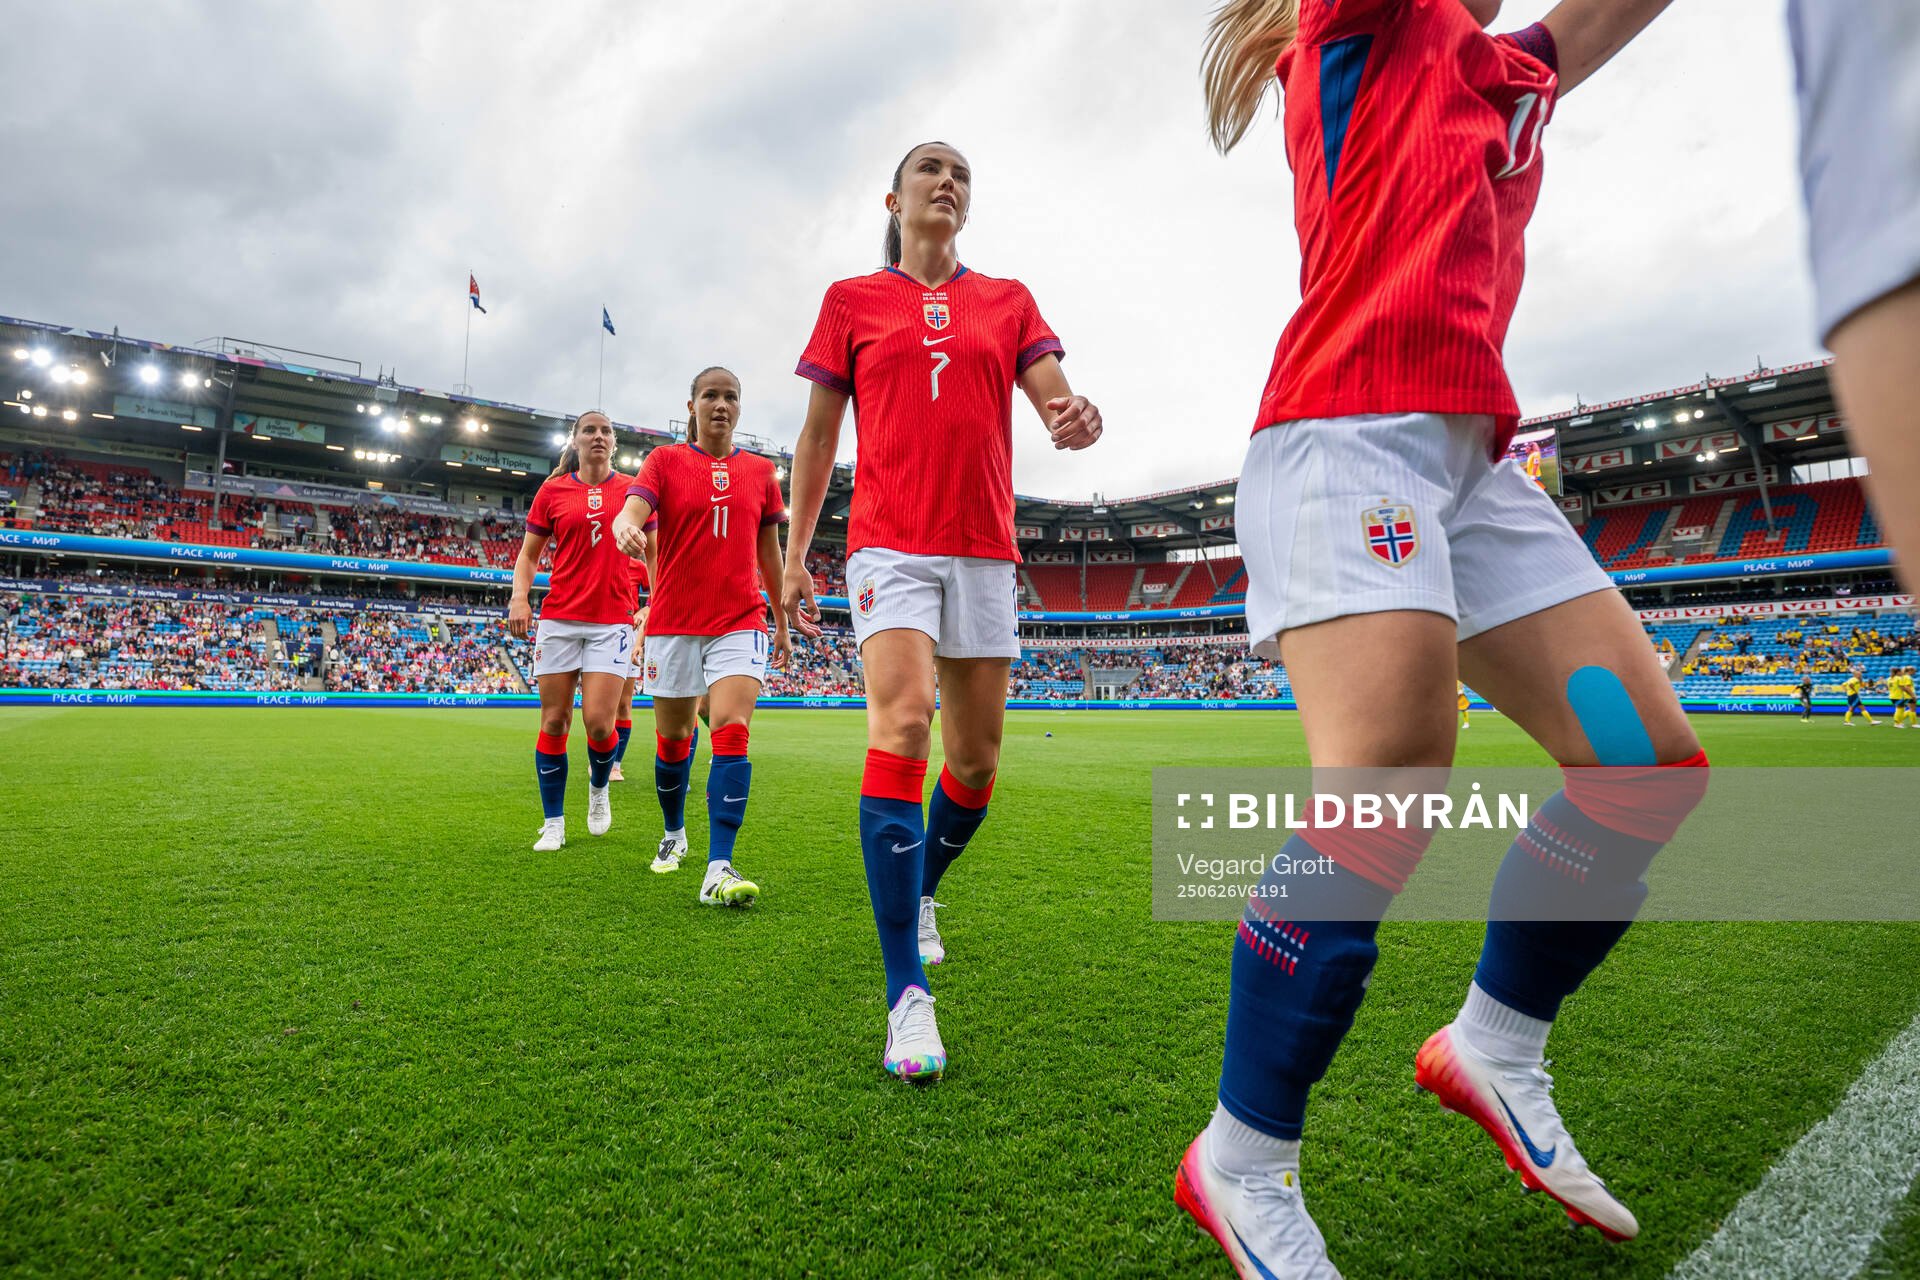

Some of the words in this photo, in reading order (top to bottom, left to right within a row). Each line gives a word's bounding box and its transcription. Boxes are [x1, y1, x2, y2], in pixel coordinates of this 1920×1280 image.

[931, 351, 951, 402] 7
[1663, 432, 1739, 459] VG
[475, 453, 501, 466] Norsk
[502, 456, 532, 470] Tipping
[1696, 468, 1777, 491] VG
[1598, 482, 1665, 505] VG
[713, 504, 729, 539] 11
[591, 520, 602, 548] 2
[1135, 525, 1178, 536] VG
[1673, 528, 1704, 540] VG
[32, 536, 60, 546] МИР
[171, 547, 203, 558] PEACE
[214, 551, 238, 560] МИР
[1031, 553, 1073, 563] VG
[1093, 552, 1134, 563] VG
[332, 560, 359, 570] PEACE
[368, 563, 389, 571] МИР
[1744, 561, 1777, 573] PEACE
[1788, 559, 1814, 569] МИР
[470, 571, 495, 581] PEACE
[1625, 573, 1646, 582] МИР
[17, 581, 42, 591] Tipping
[69, 585, 88, 594] Norsk
[89, 586, 112, 595] Tipping
[137, 590, 156, 598] Norsk
[156, 590, 178, 599] Tipping
[202, 593, 219, 601] Norsk
[262, 597, 279, 605] Norsk
[279, 598, 298, 606] Tipping
[336, 601, 354, 609] Tipping
[1782, 601, 1826, 613] VG
[1836, 597, 1883, 610] VG
[1640, 610, 1678, 620] VG
[1685, 607, 1724, 618] VG
[1732, 604, 1774, 616] VG
[621, 630, 627, 652] 2
[755, 629, 764, 656] 11
[52, 693, 93, 704] PEACE
[107, 693, 137, 704] МИР
[257, 695, 291, 705] PEACE
[302, 696, 327, 705] МИР
[428, 697, 457, 706] PEACE
[466, 697, 487, 706] МИР
[1718, 703, 1754, 712] PEACE
[1767, 703, 1795, 712] МИР
